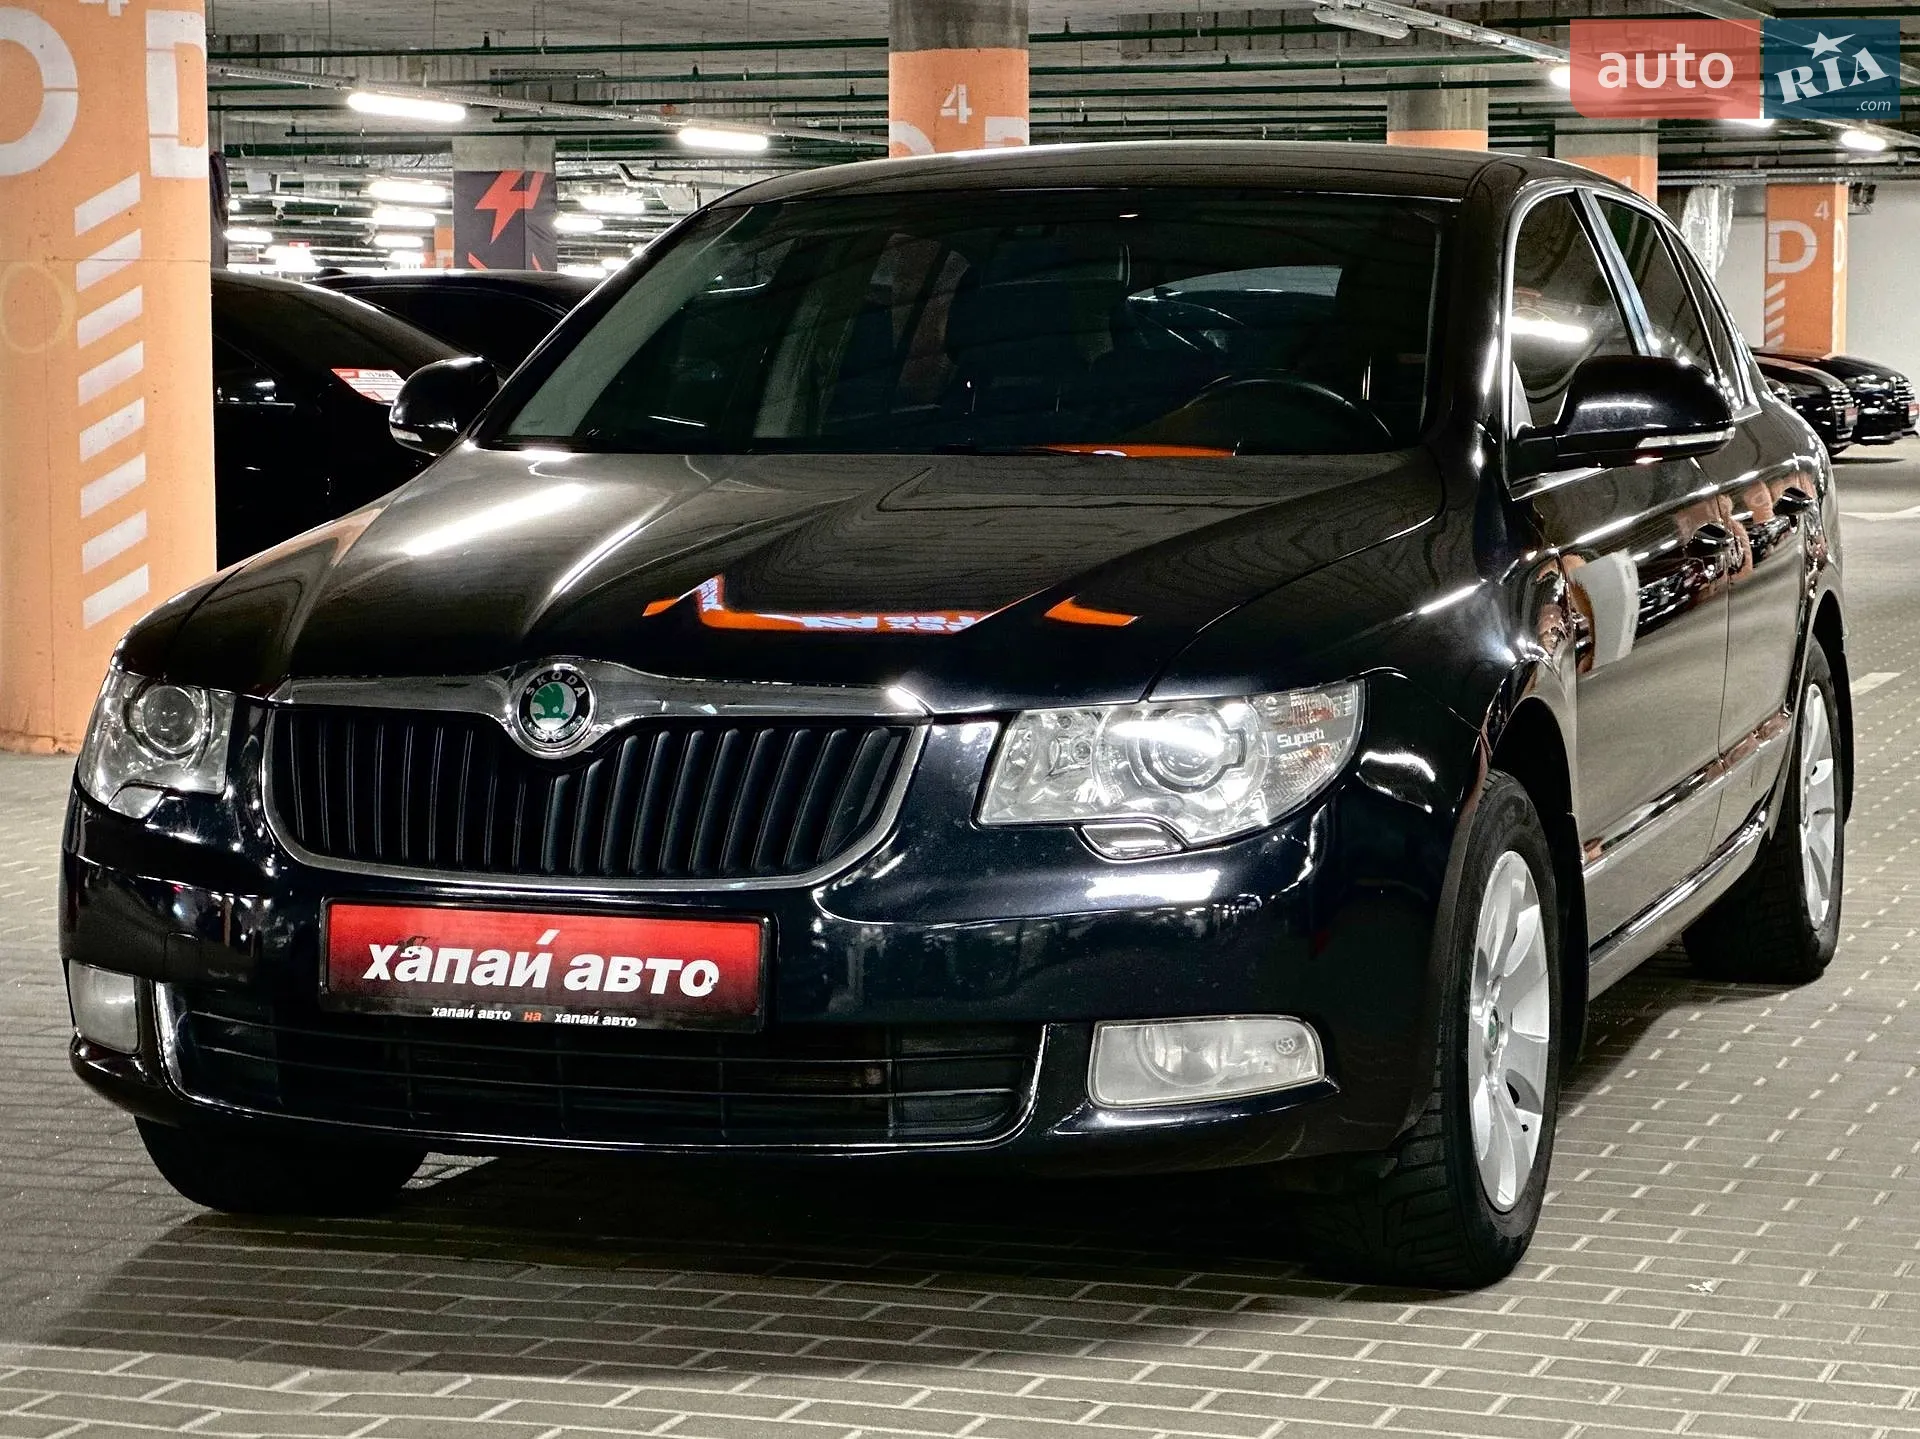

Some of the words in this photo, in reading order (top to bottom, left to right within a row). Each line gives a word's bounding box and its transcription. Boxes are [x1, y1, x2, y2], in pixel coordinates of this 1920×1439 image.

[940, 83, 973, 124] 4
[1814, 200, 1831, 220] 4
[1767, 219, 1818, 274] D
[1276, 727, 1325, 749] Superb
[563, 953, 720, 998] авто
[477, 1007, 511, 1021] авто
[523, 1010, 544, 1022] на
[602, 1013, 637, 1027] авто
